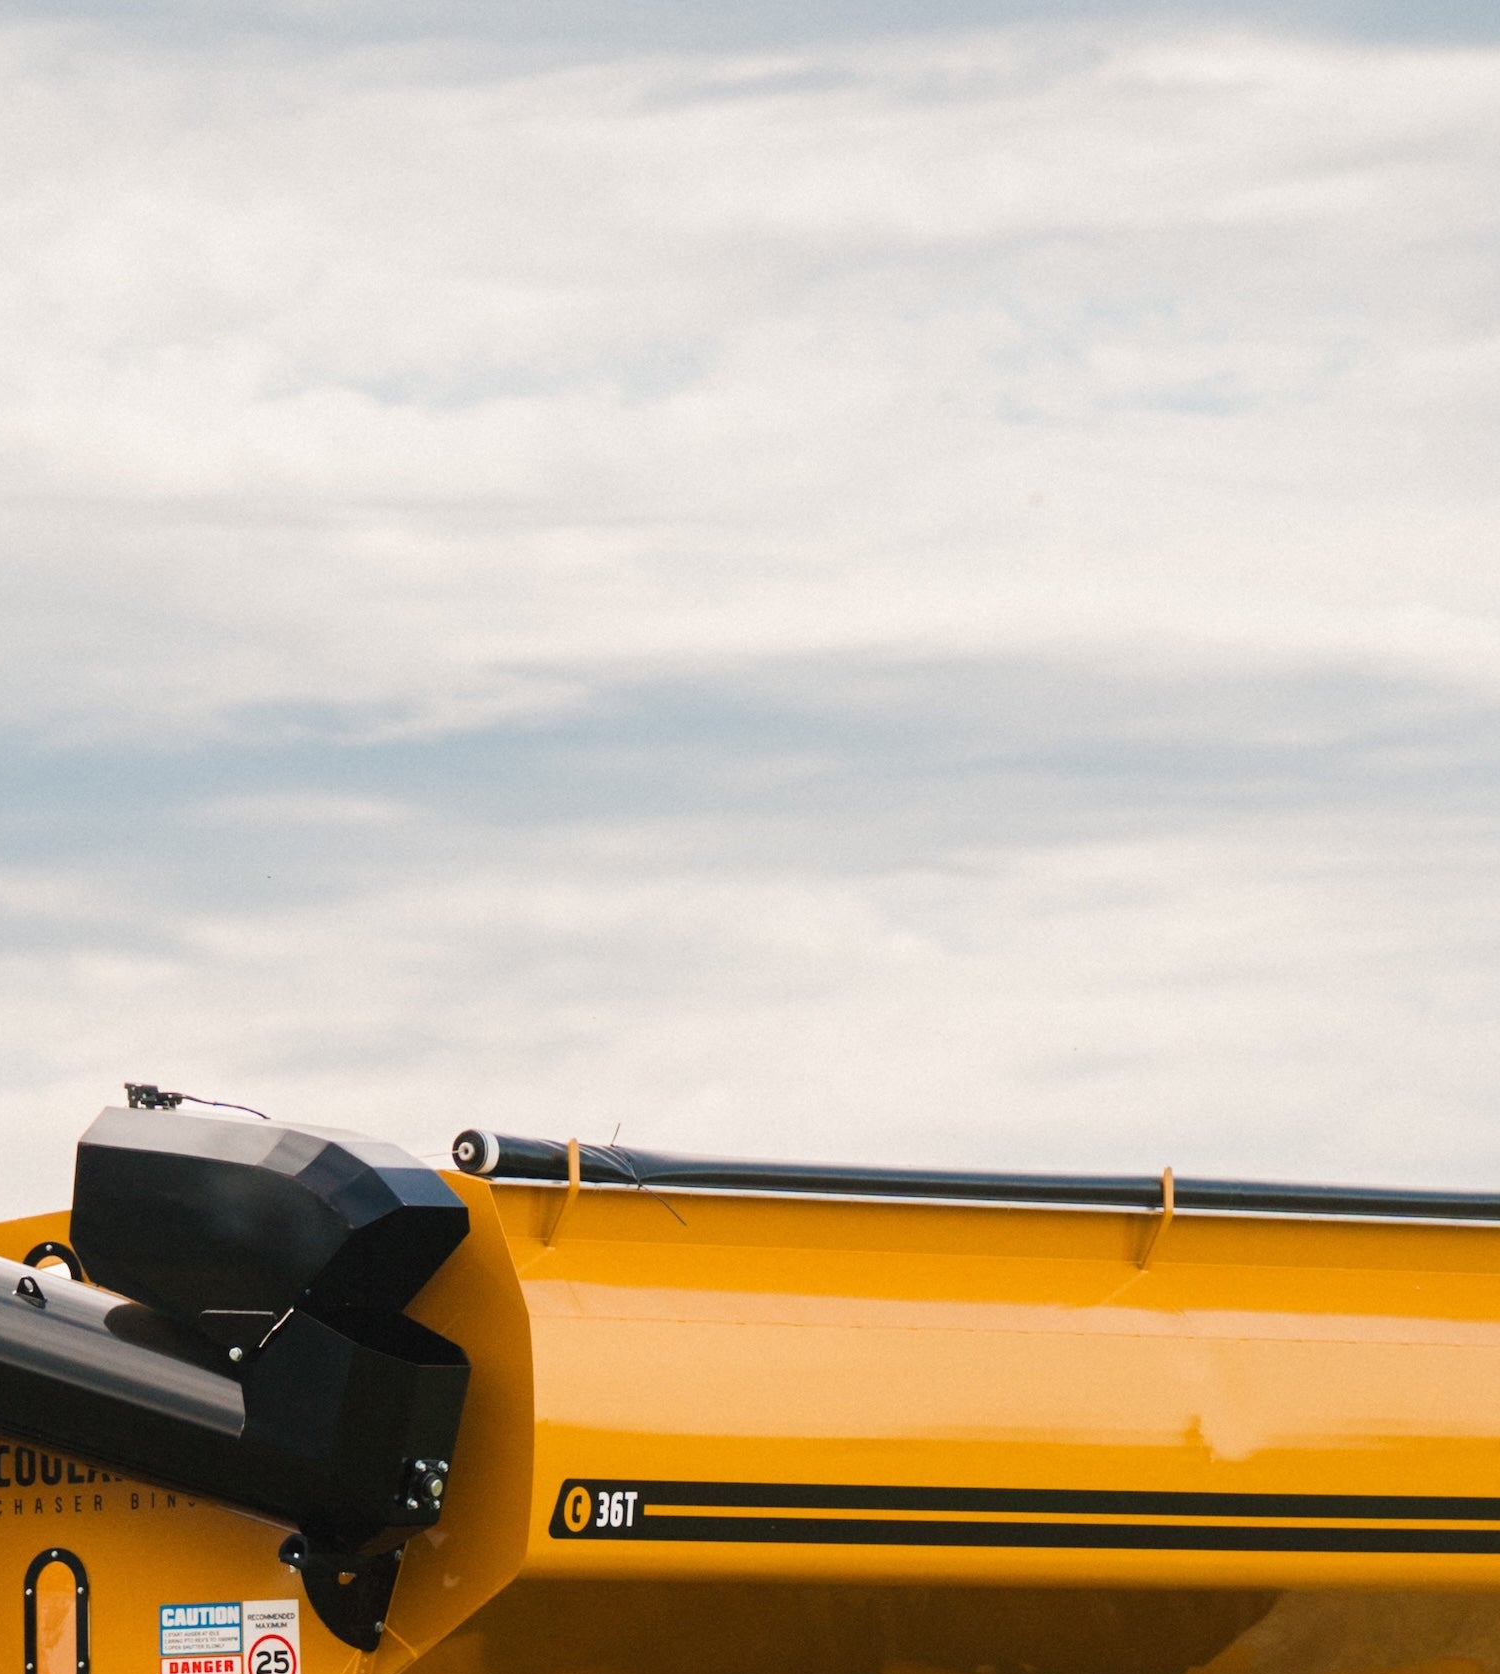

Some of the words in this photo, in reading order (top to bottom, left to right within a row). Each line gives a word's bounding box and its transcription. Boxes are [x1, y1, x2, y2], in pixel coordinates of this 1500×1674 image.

[131, 1492, 197, 1510] BIN
[596, 1491, 638, 1527] 36T
[161, 1605, 240, 1627] CAUTION
[247, 1612, 295, 1621] RECOMMENDED
[169, 1660, 234, 1674] DANGER
[256, 1650, 290, 1674] 25
